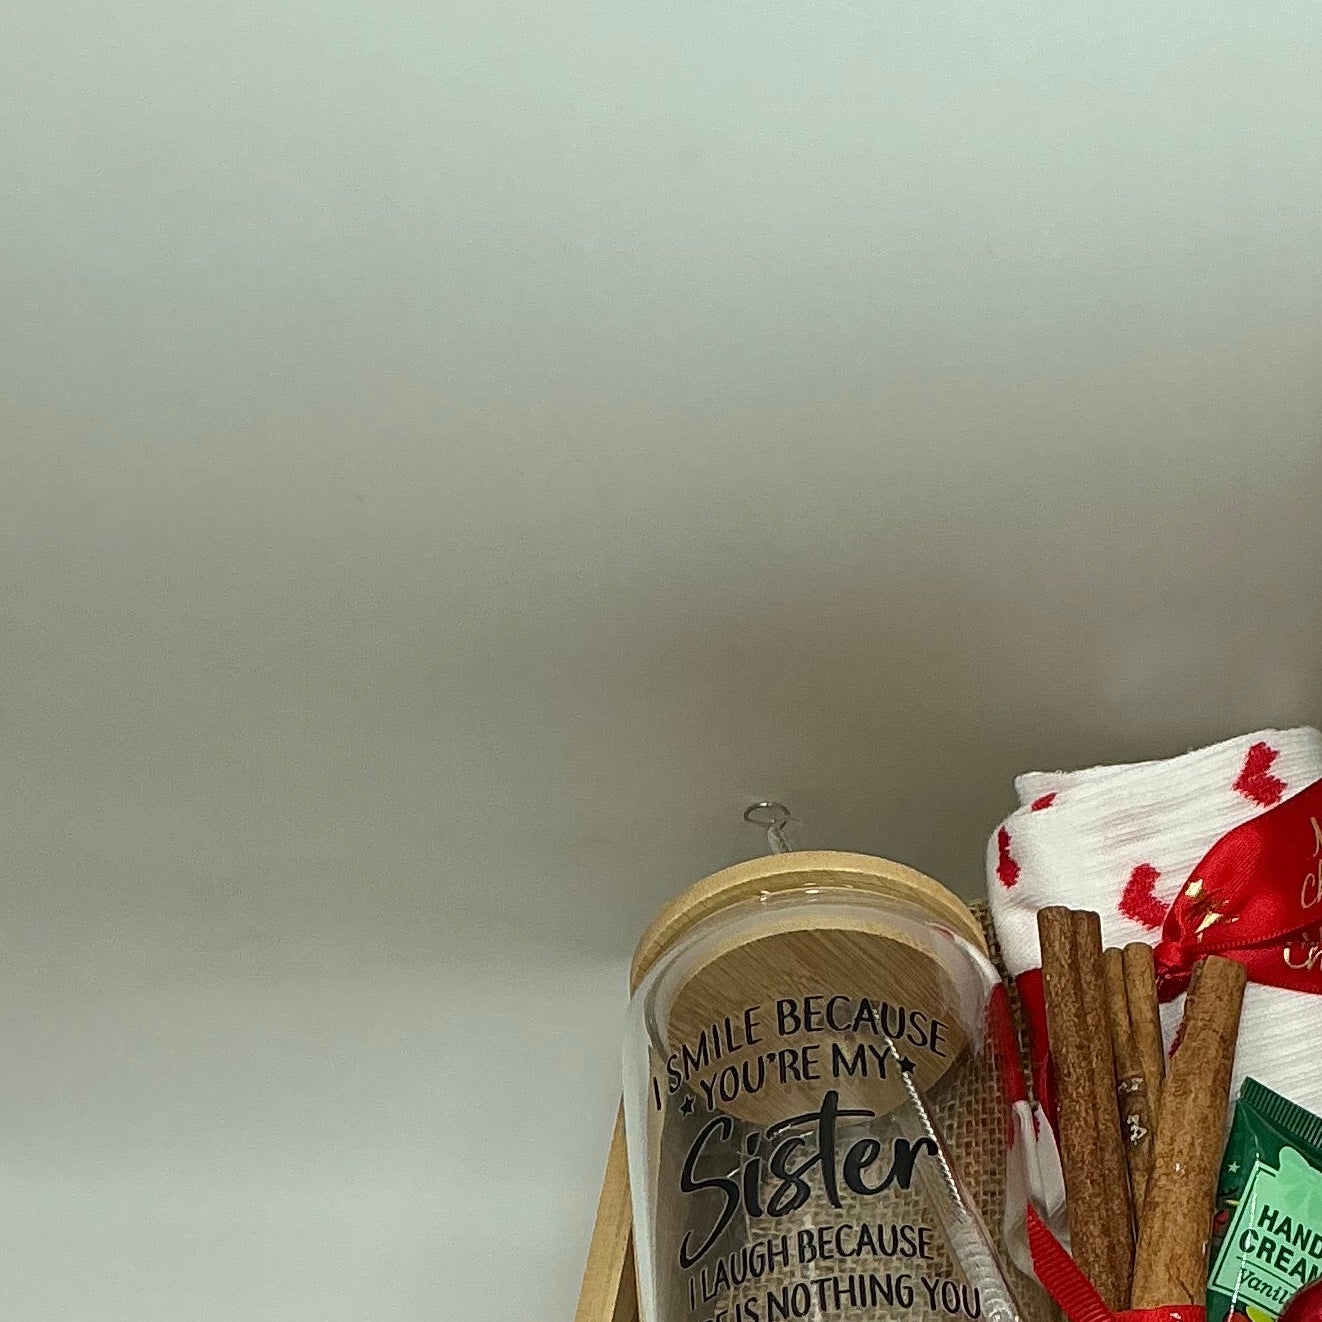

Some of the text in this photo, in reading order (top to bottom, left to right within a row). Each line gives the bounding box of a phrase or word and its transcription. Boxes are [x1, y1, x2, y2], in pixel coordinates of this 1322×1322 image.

[652, 995, 949, 1112] I SMILE BECAUSE
[700, 1042, 893, 1112] YOU'RE MY
[679, 1090, 940, 1270] Sister
[688, 1223, 935, 1312] I LAUGH BECAUSE
[920, 1275, 983, 1320] YOU
[1241, 1267, 1294, 1305] Vanil
